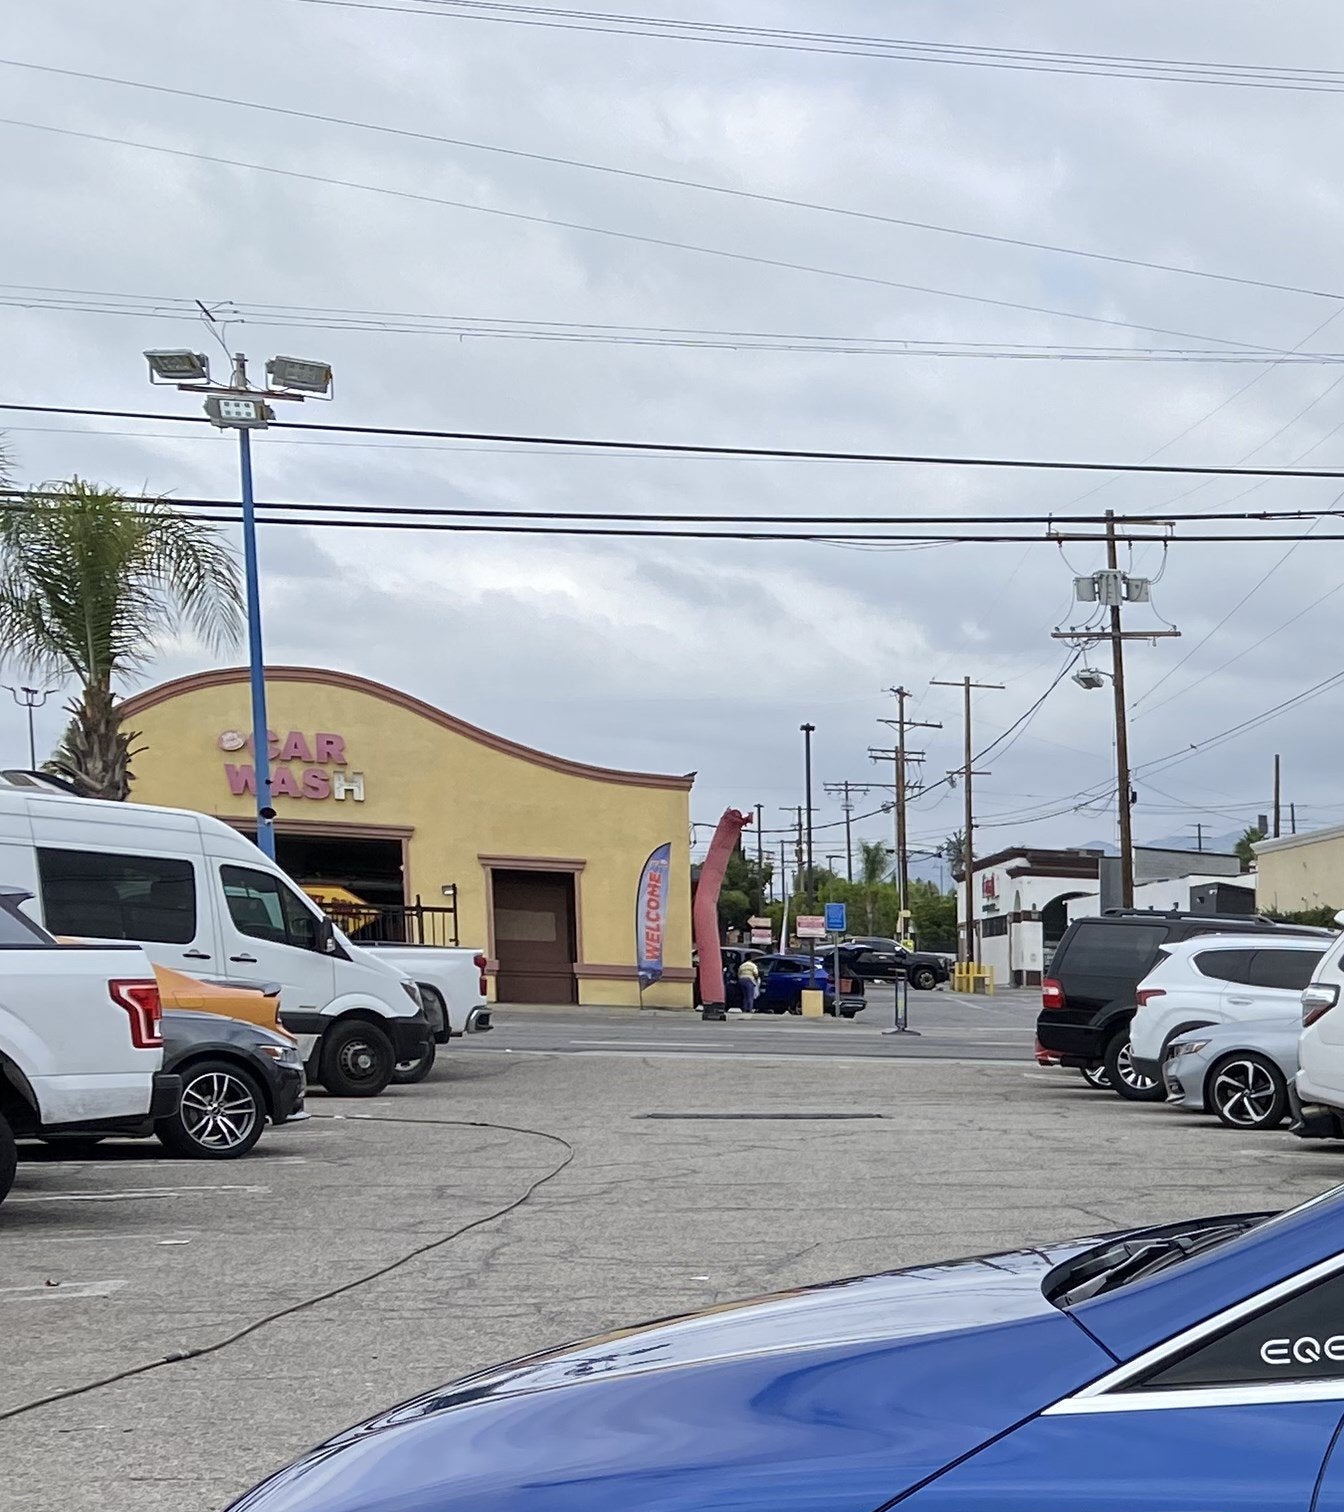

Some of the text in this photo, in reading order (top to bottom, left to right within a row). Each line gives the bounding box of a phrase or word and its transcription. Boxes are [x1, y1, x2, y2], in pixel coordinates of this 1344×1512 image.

[246, 730, 347, 765] CAR
[224, 764, 365, 802] WASH
[644, 871, 662, 961] WELCOME
